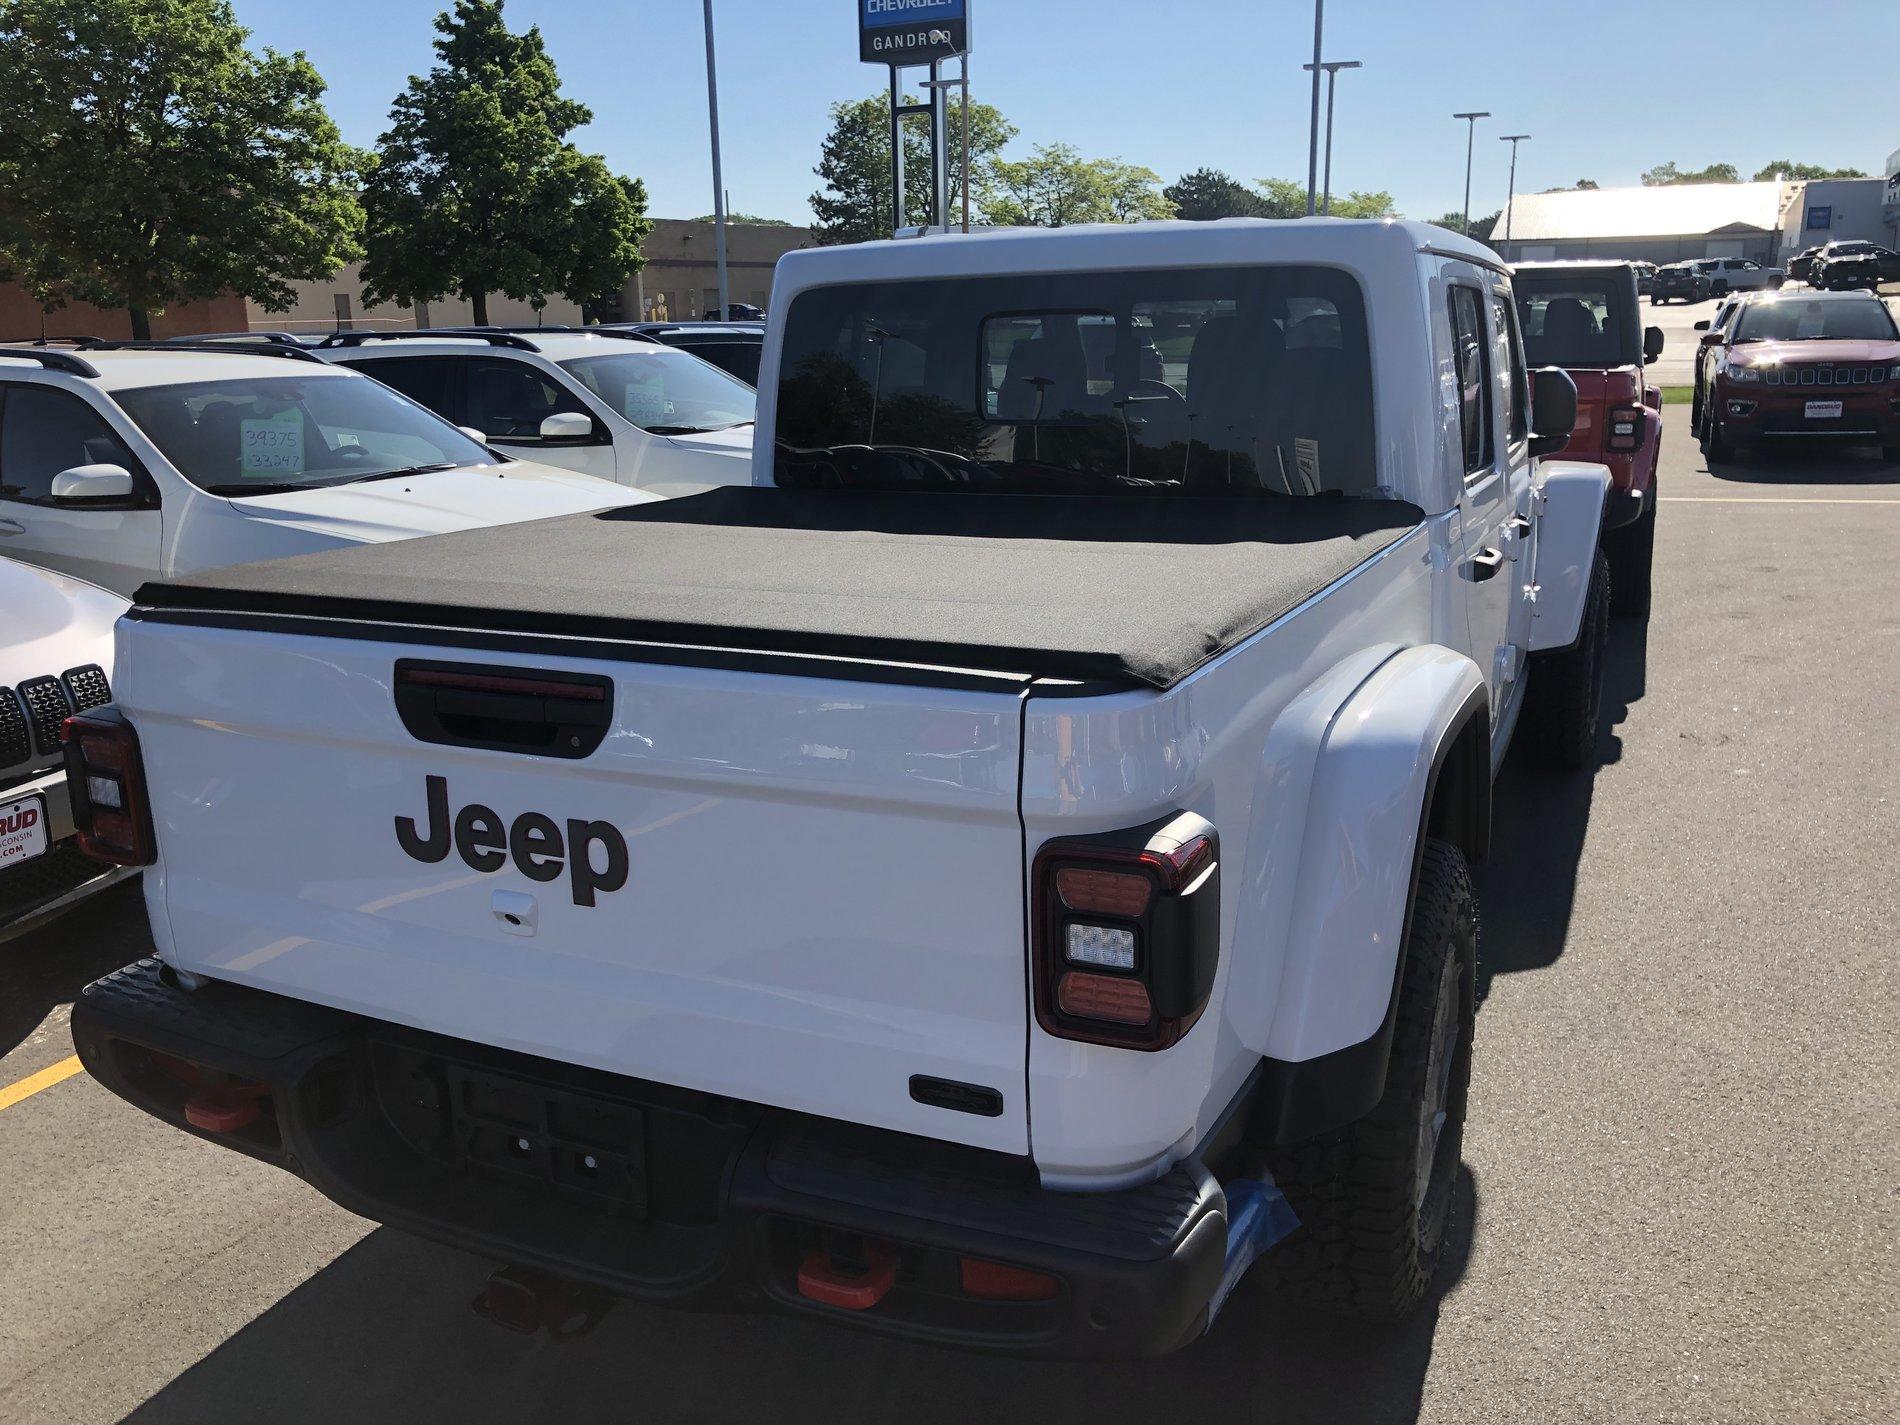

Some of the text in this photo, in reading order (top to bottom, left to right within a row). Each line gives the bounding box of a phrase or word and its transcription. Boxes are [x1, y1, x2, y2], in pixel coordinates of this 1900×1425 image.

[867, 0, 952, 13] CHEVRO
[246, 430, 297, 447] 39375
[0, 831, 33, 847] CONSIN
[394, 774, 630, 908] Jeep
